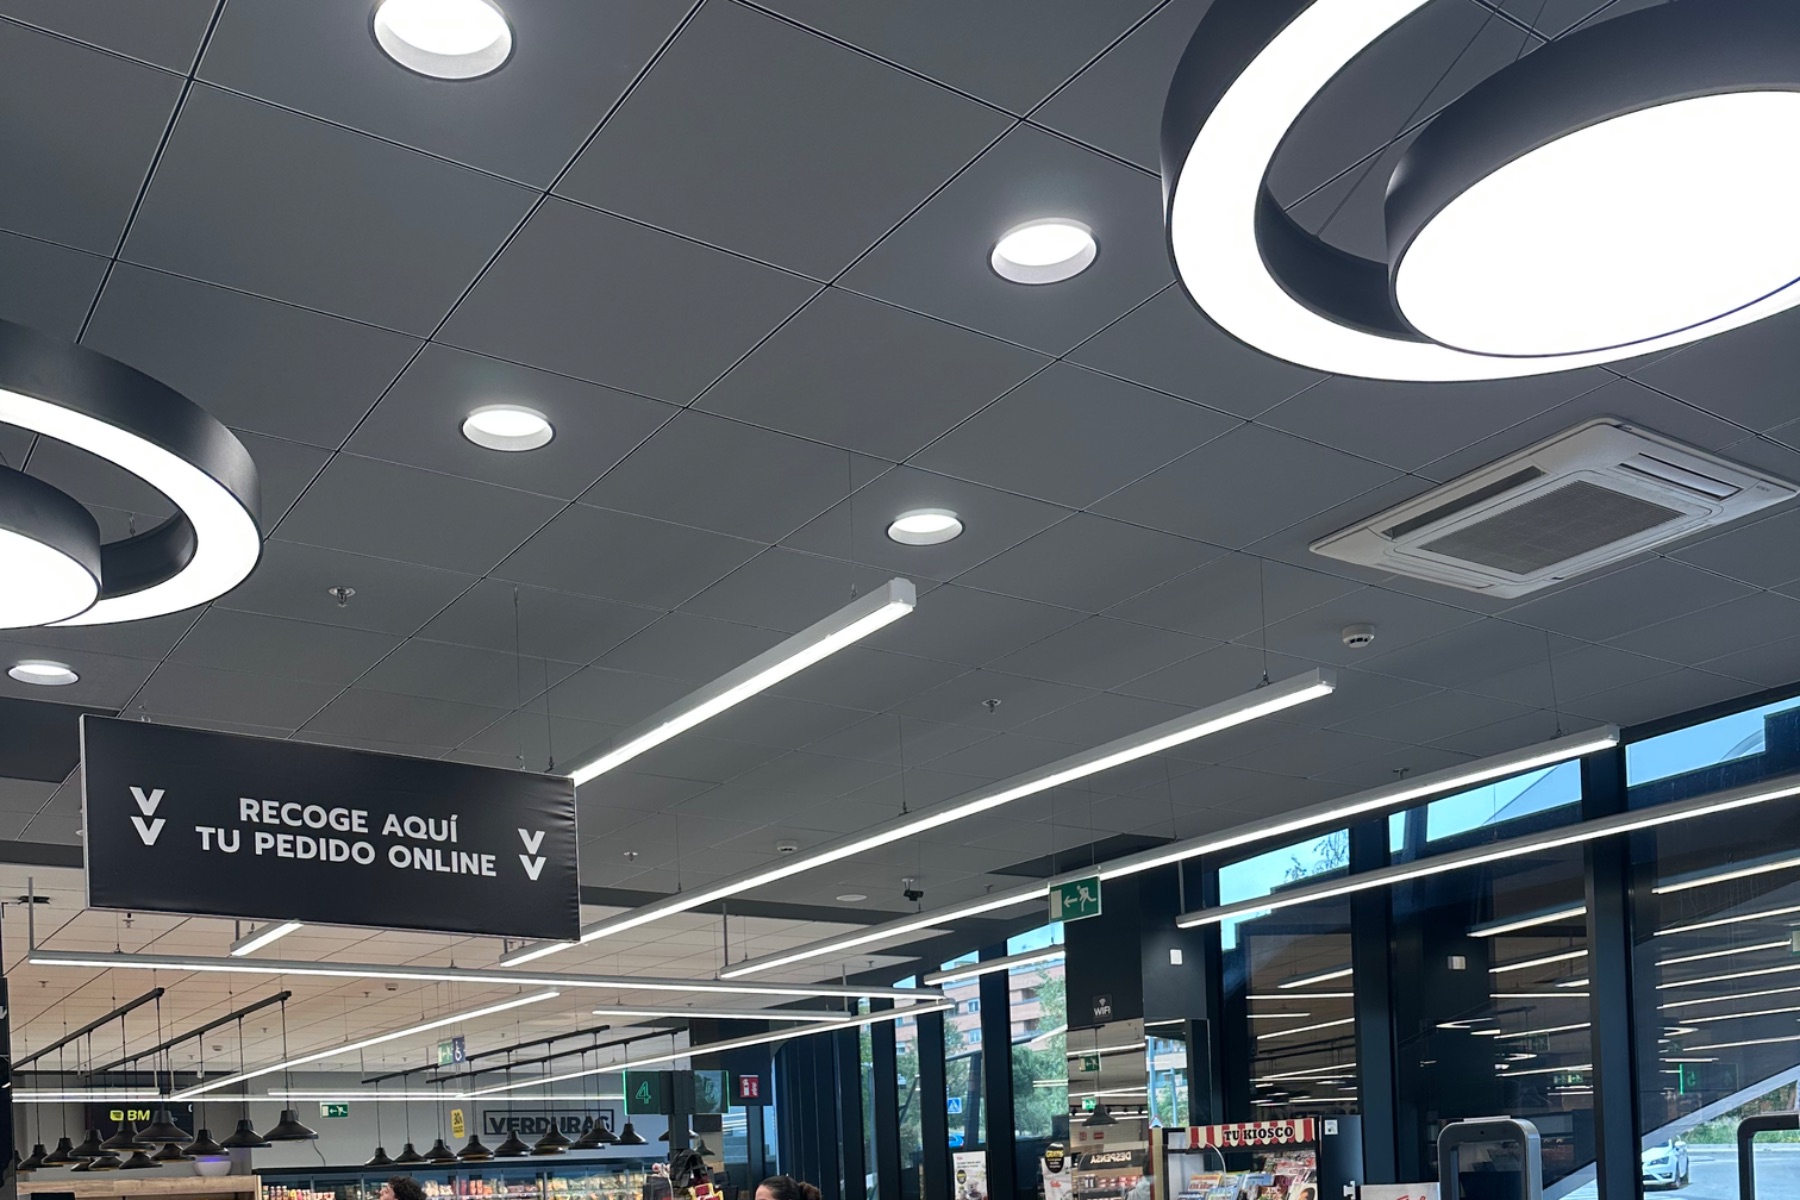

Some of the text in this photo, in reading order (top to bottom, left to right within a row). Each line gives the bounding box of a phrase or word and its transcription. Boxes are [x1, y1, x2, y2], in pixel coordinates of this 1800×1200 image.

[240, 797, 458, 842] RECOGE AQUÍ
[195, 826, 496, 877] TU PEDIDO ONLINE
[635, 1081, 651, 1104] 4
[705, 1081, 719, 1103] 5
[127, 1110, 150, 1121] BM
[1224, 1127, 1294, 1141] TU KIOSCO
